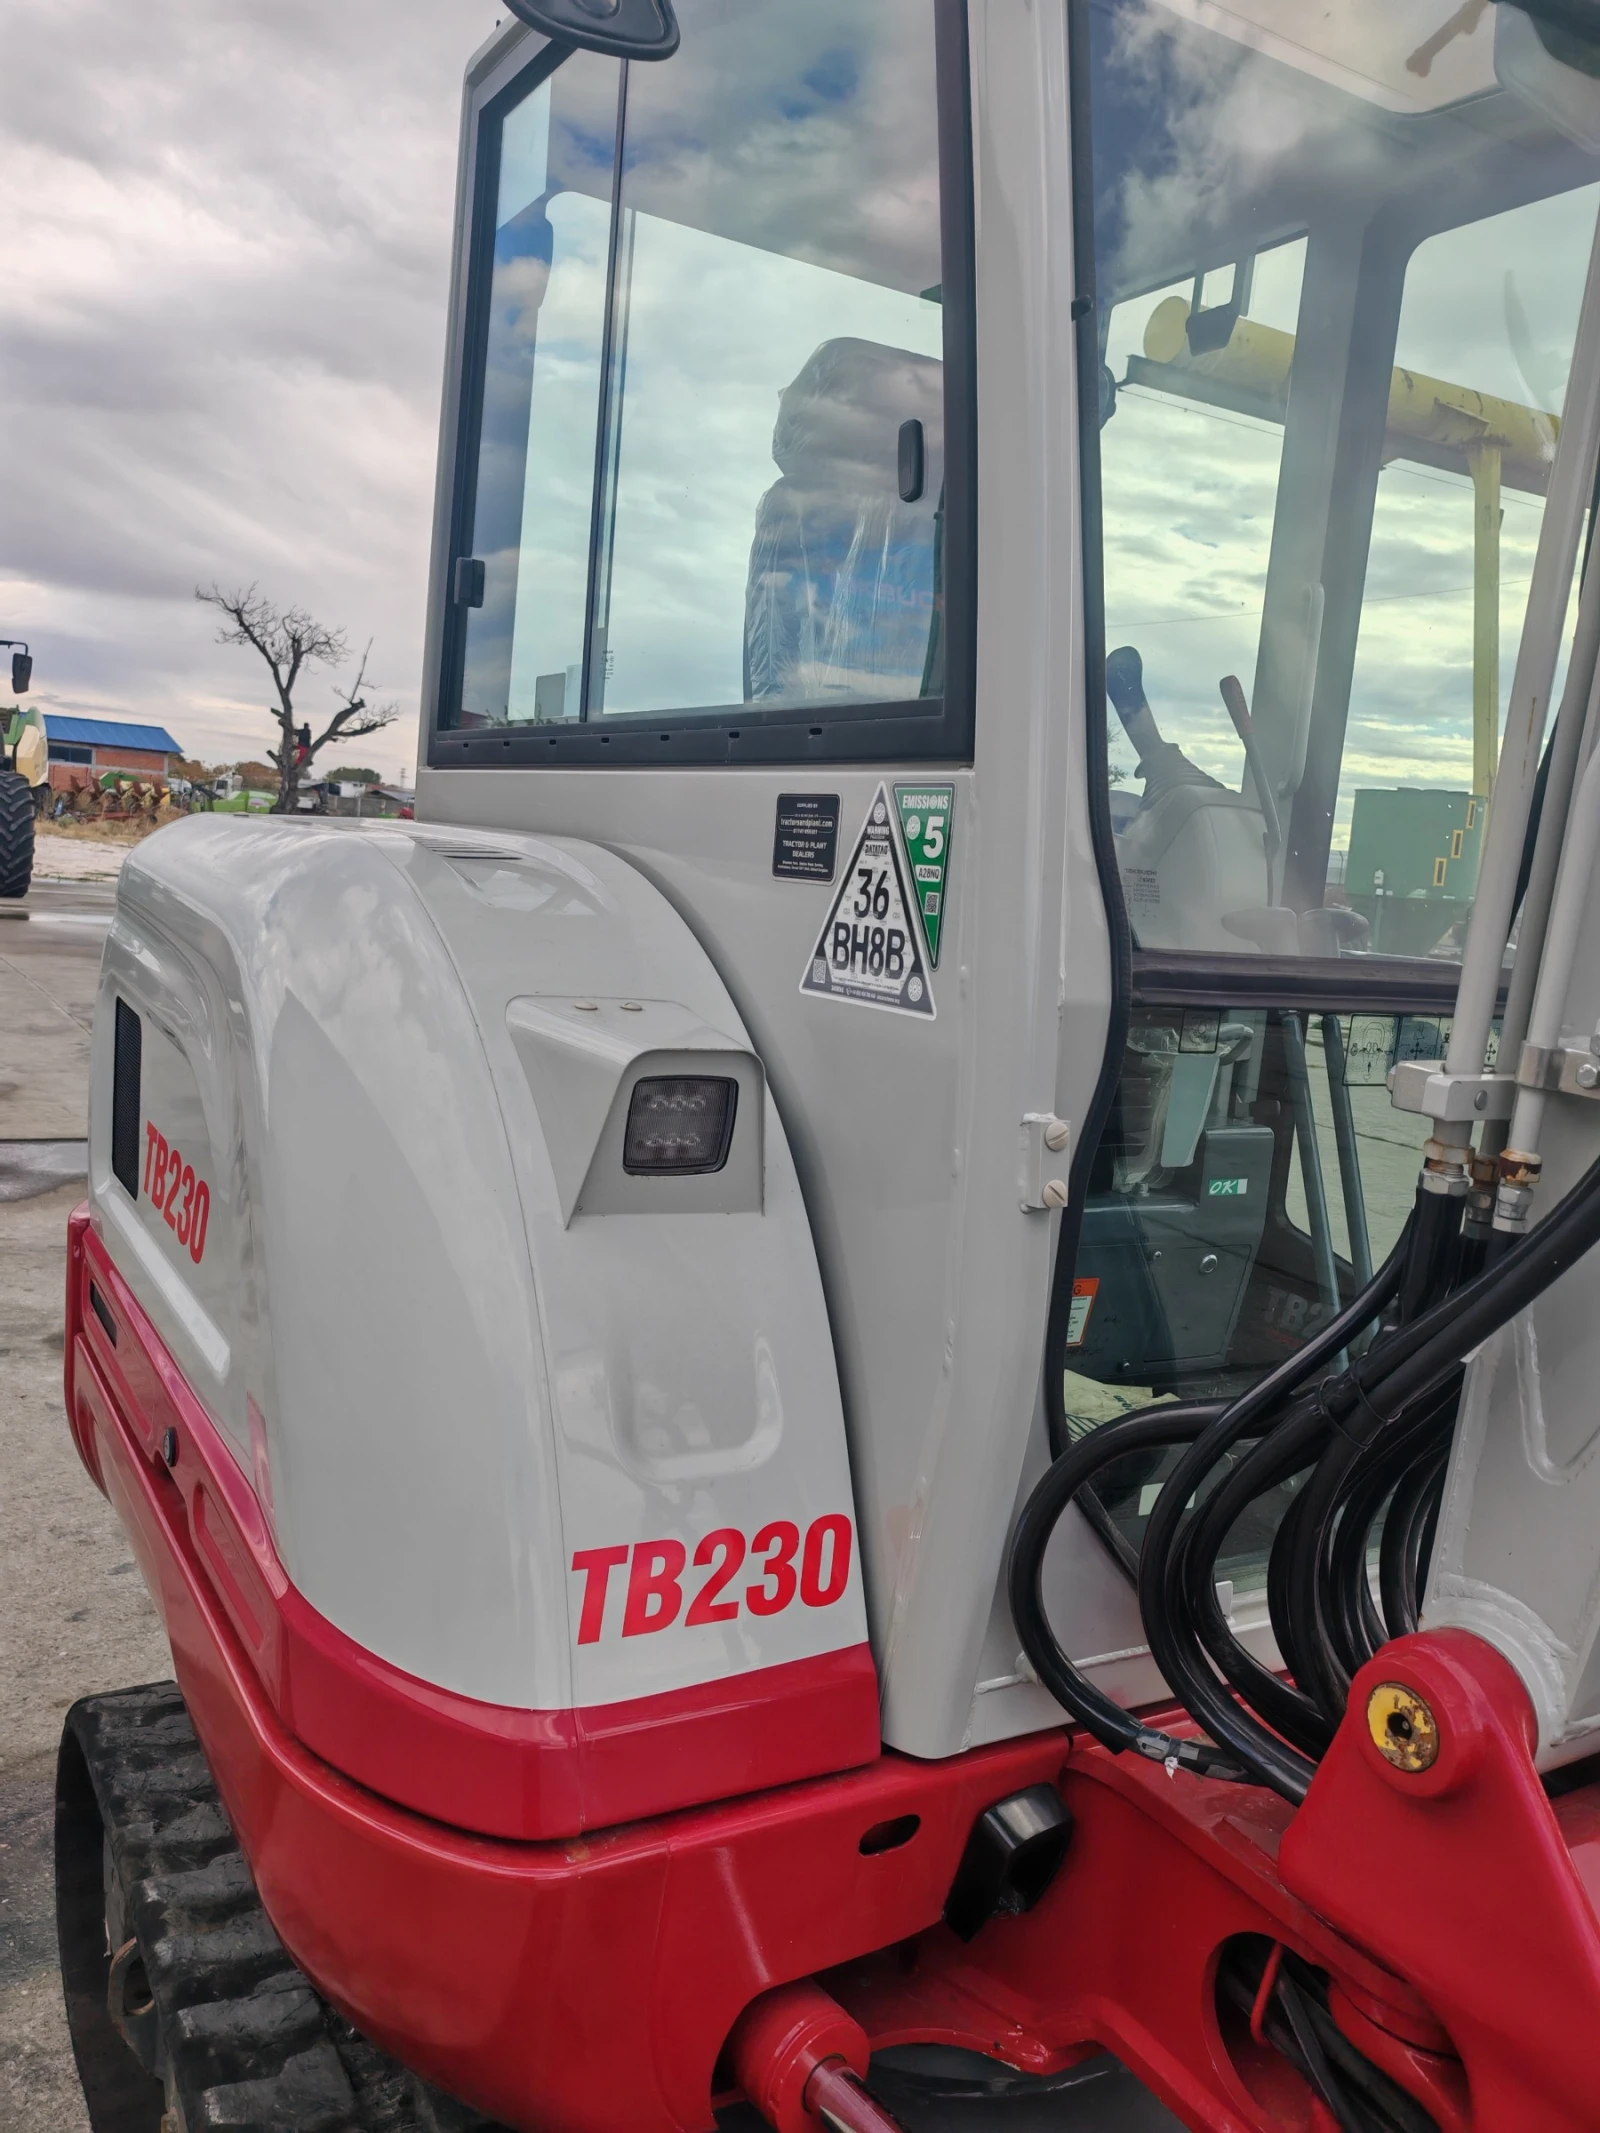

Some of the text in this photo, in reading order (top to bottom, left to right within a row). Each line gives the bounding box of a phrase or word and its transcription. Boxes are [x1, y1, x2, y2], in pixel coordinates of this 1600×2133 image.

[903, 795, 948, 809] EMISSIONS
[781, 818, 832, 828] tractorsandplant.com
[867, 825, 890, 835] WARNING
[783, 840, 804, 848] TRACTOR
[923, 816, 944, 858] 5
[793, 850, 814, 858] DEALERS
[919, 868, 939, 879] A28NQ
[854, 868, 889, 920] 36
[832, 922, 905, 980] BH8B
[144, 1120, 210, 1264] TB230
[1209, 1180, 1237, 1194] OK
[1264, 1285, 1335, 1339] TB2
[571, 1513, 852, 1645] TB230
